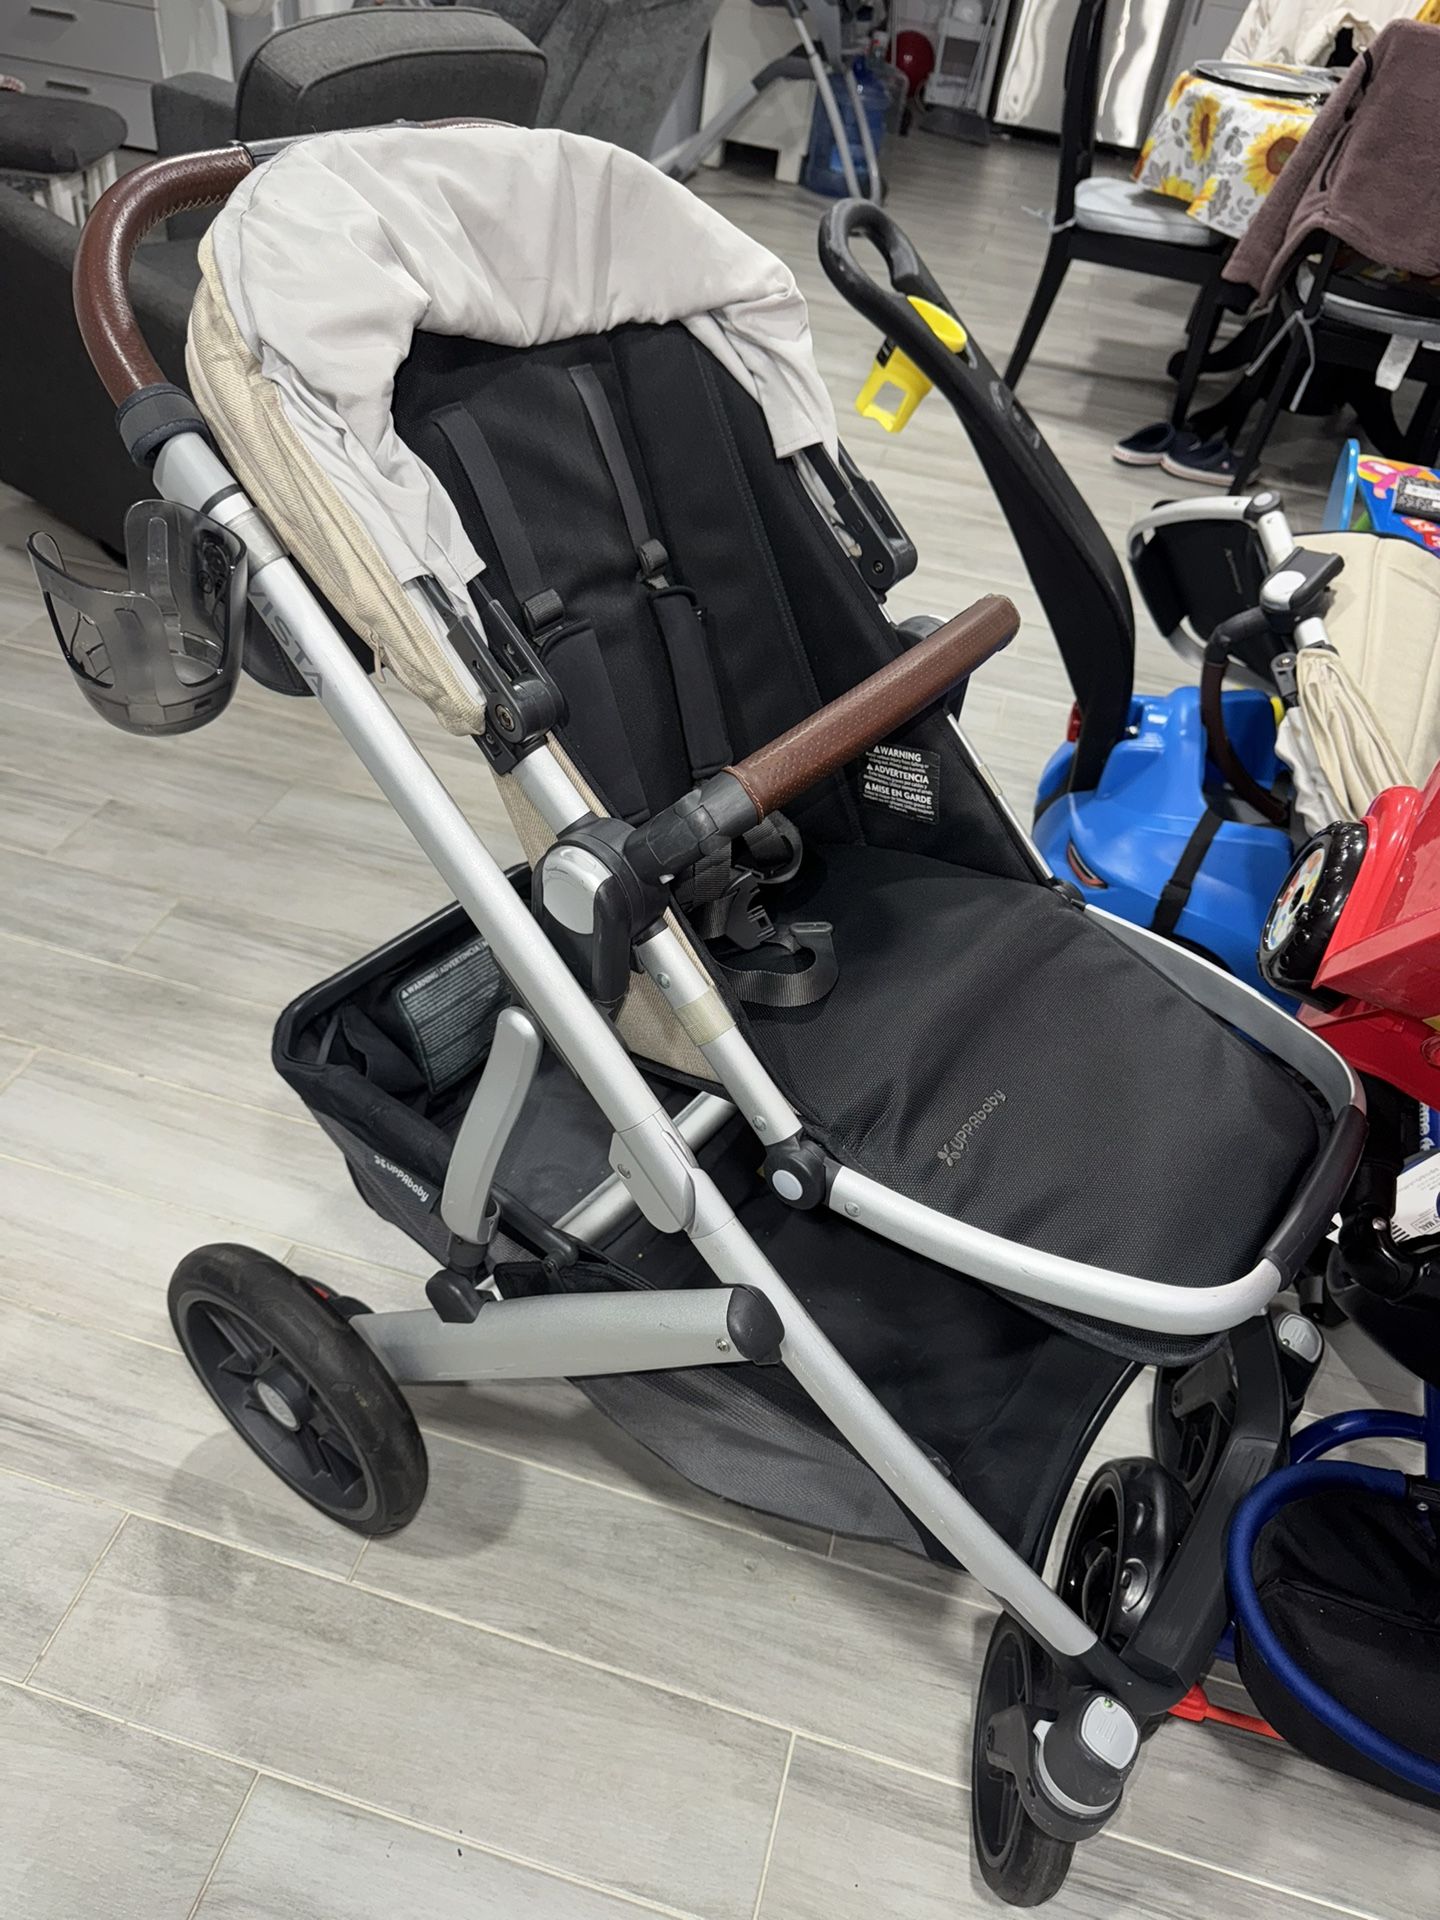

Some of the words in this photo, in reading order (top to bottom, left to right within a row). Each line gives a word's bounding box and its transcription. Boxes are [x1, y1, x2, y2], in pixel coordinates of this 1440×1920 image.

[880, 746, 921, 762] WARNING
[874, 764, 929, 785] ADVERTENCIA
[871, 783, 890, 795] MISE
[891, 788, 902, 798] EN
[903, 791, 932, 805] GARDE
